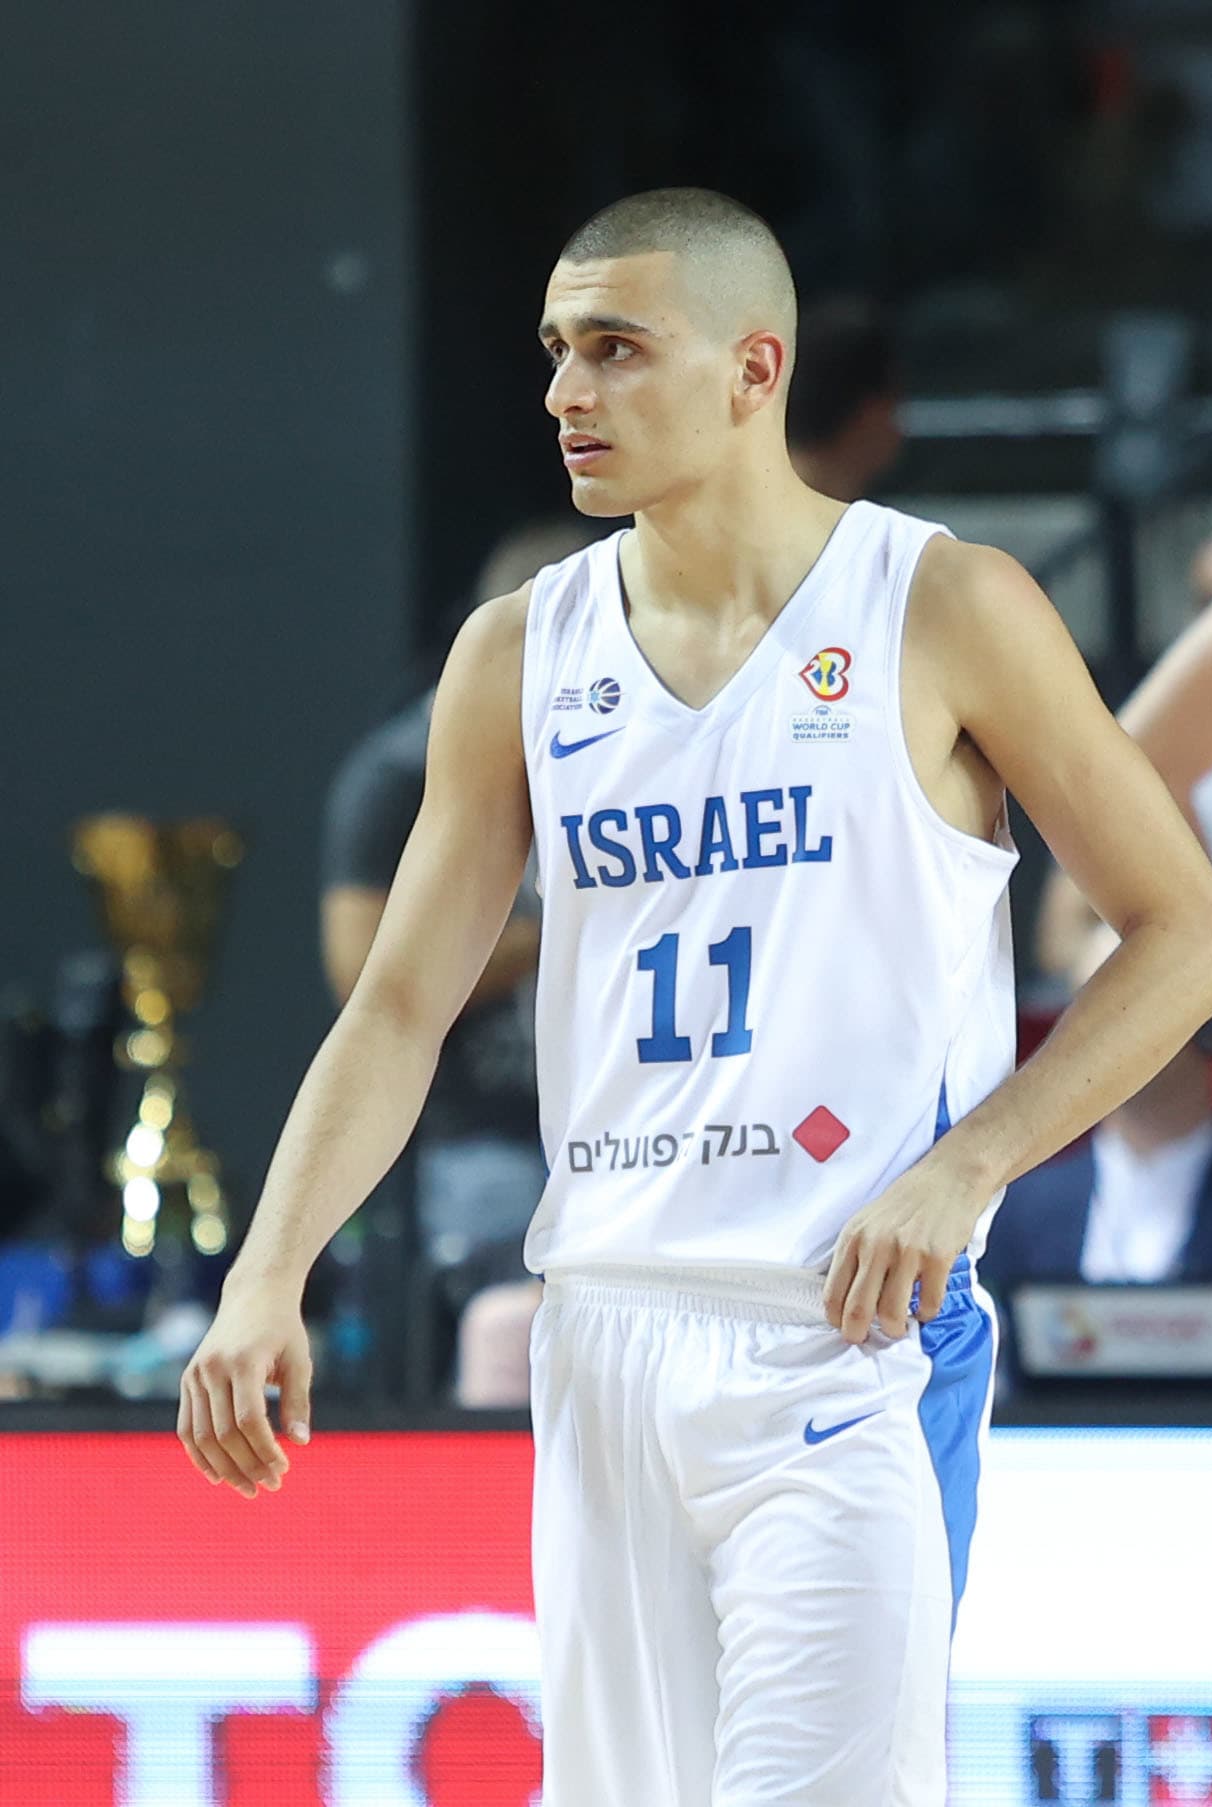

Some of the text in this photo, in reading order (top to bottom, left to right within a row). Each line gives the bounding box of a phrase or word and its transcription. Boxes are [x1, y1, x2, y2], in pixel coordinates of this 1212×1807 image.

[792, 723, 851, 731] WORLD CUP
[561, 785, 833, 890] ISRAEL
[636, 926, 753, 1064] 11
